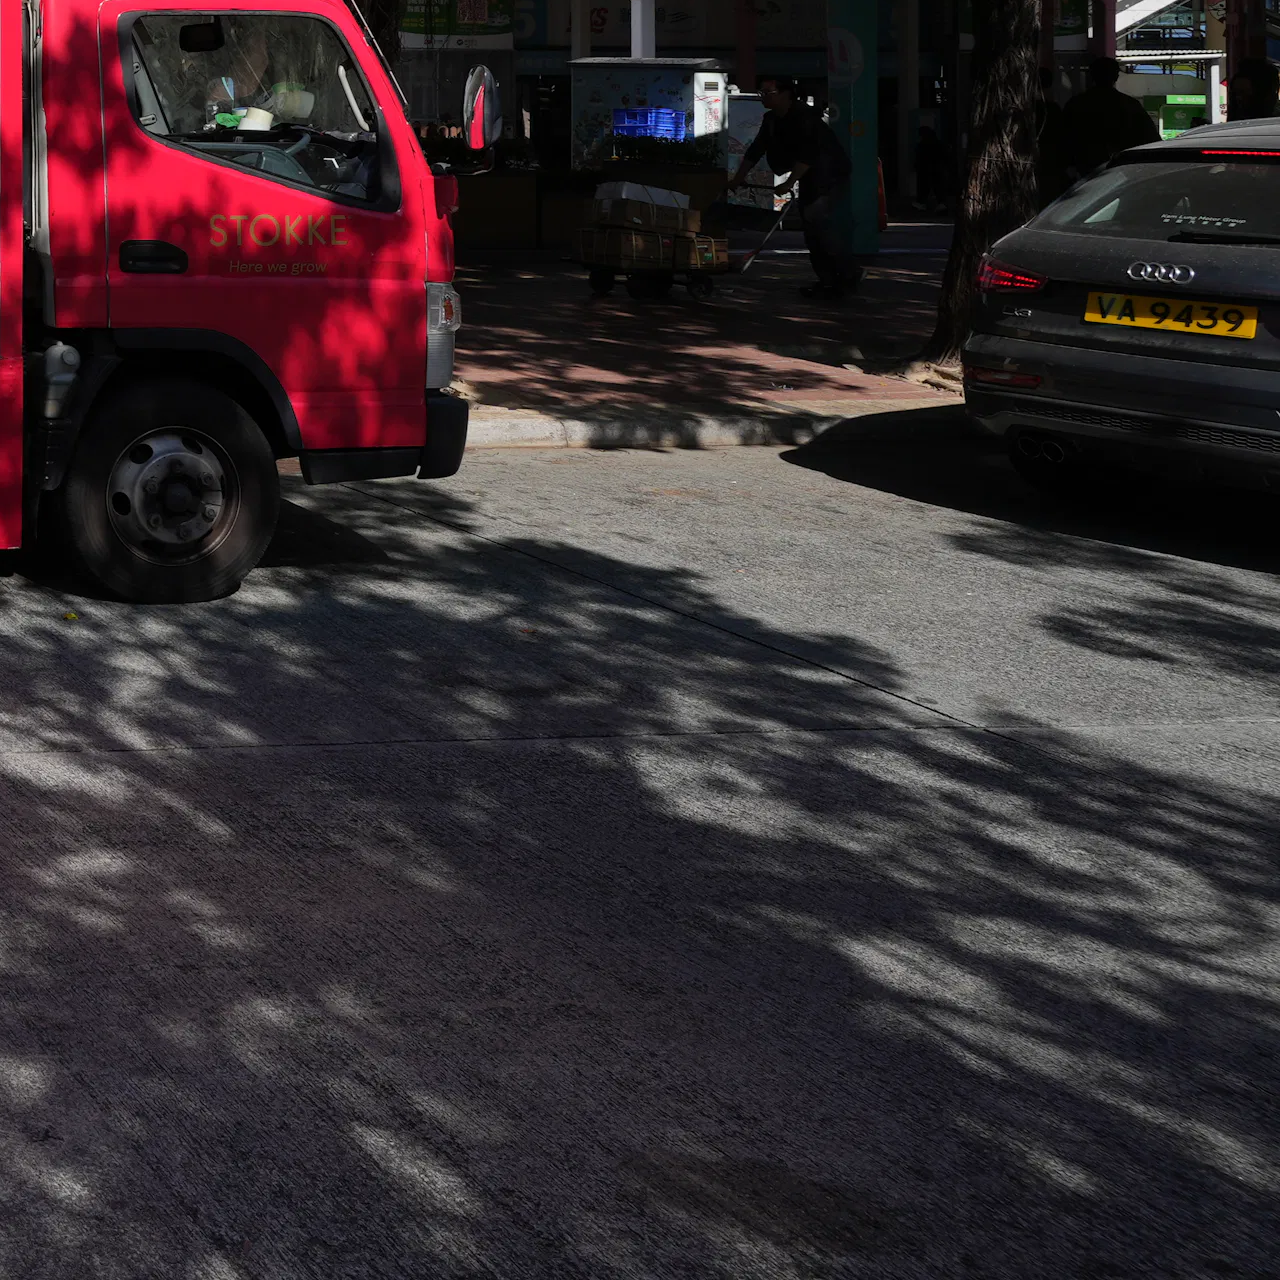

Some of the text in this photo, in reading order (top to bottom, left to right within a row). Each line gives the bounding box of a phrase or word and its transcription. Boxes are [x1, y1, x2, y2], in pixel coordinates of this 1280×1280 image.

[209, 214, 348, 247] STOKKE
[229, 260, 327, 276] Here we grow
[1097, 295, 1245, 332] VA 9439
